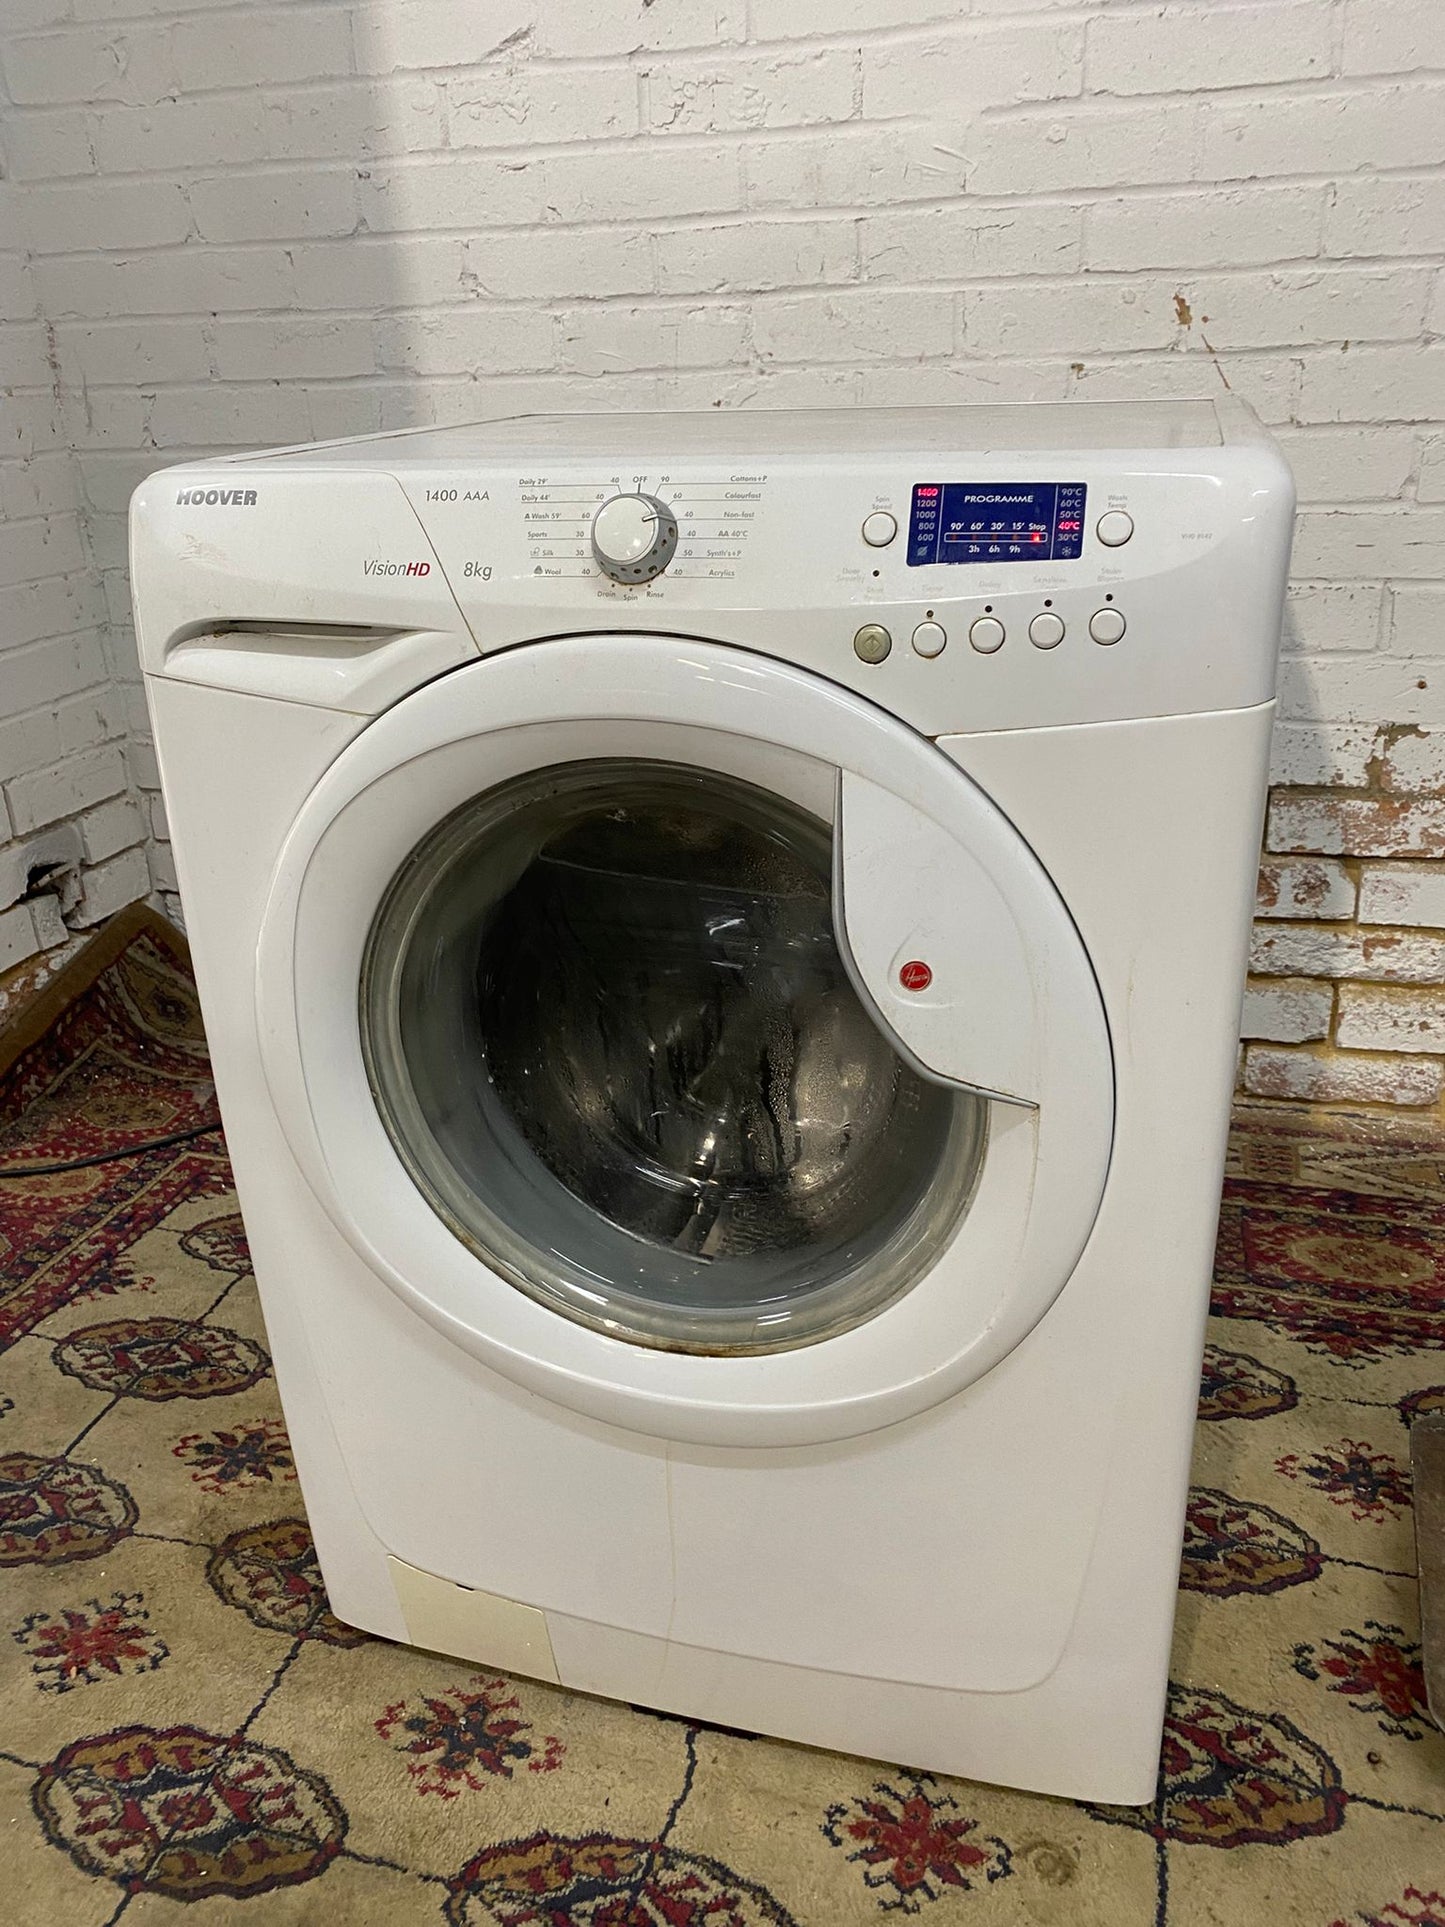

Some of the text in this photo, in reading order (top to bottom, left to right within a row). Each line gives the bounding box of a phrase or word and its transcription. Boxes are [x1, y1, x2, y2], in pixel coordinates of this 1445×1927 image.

[519, 478, 536, 487] Daily
[426, 490, 490, 502] 1400 AAA
[917, 488, 938, 496] 1400
[1061, 488, 1082, 496] 90°C
[176, 490, 258, 506] HOOVER
[522, 494, 538, 503] Daily
[964, 495, 1034, 503] PROGRAMME
[1028, 522, 1046, 532] Stop
[1058, 522, 1080, 530] 40°C
[1057, 533, 1078, 542] 30°C
[968, 544, 1020, 553] 3h 6h 9h
[363, 560, 430, 577] VisionHD
[464, 562, 492, 580] 8kg
